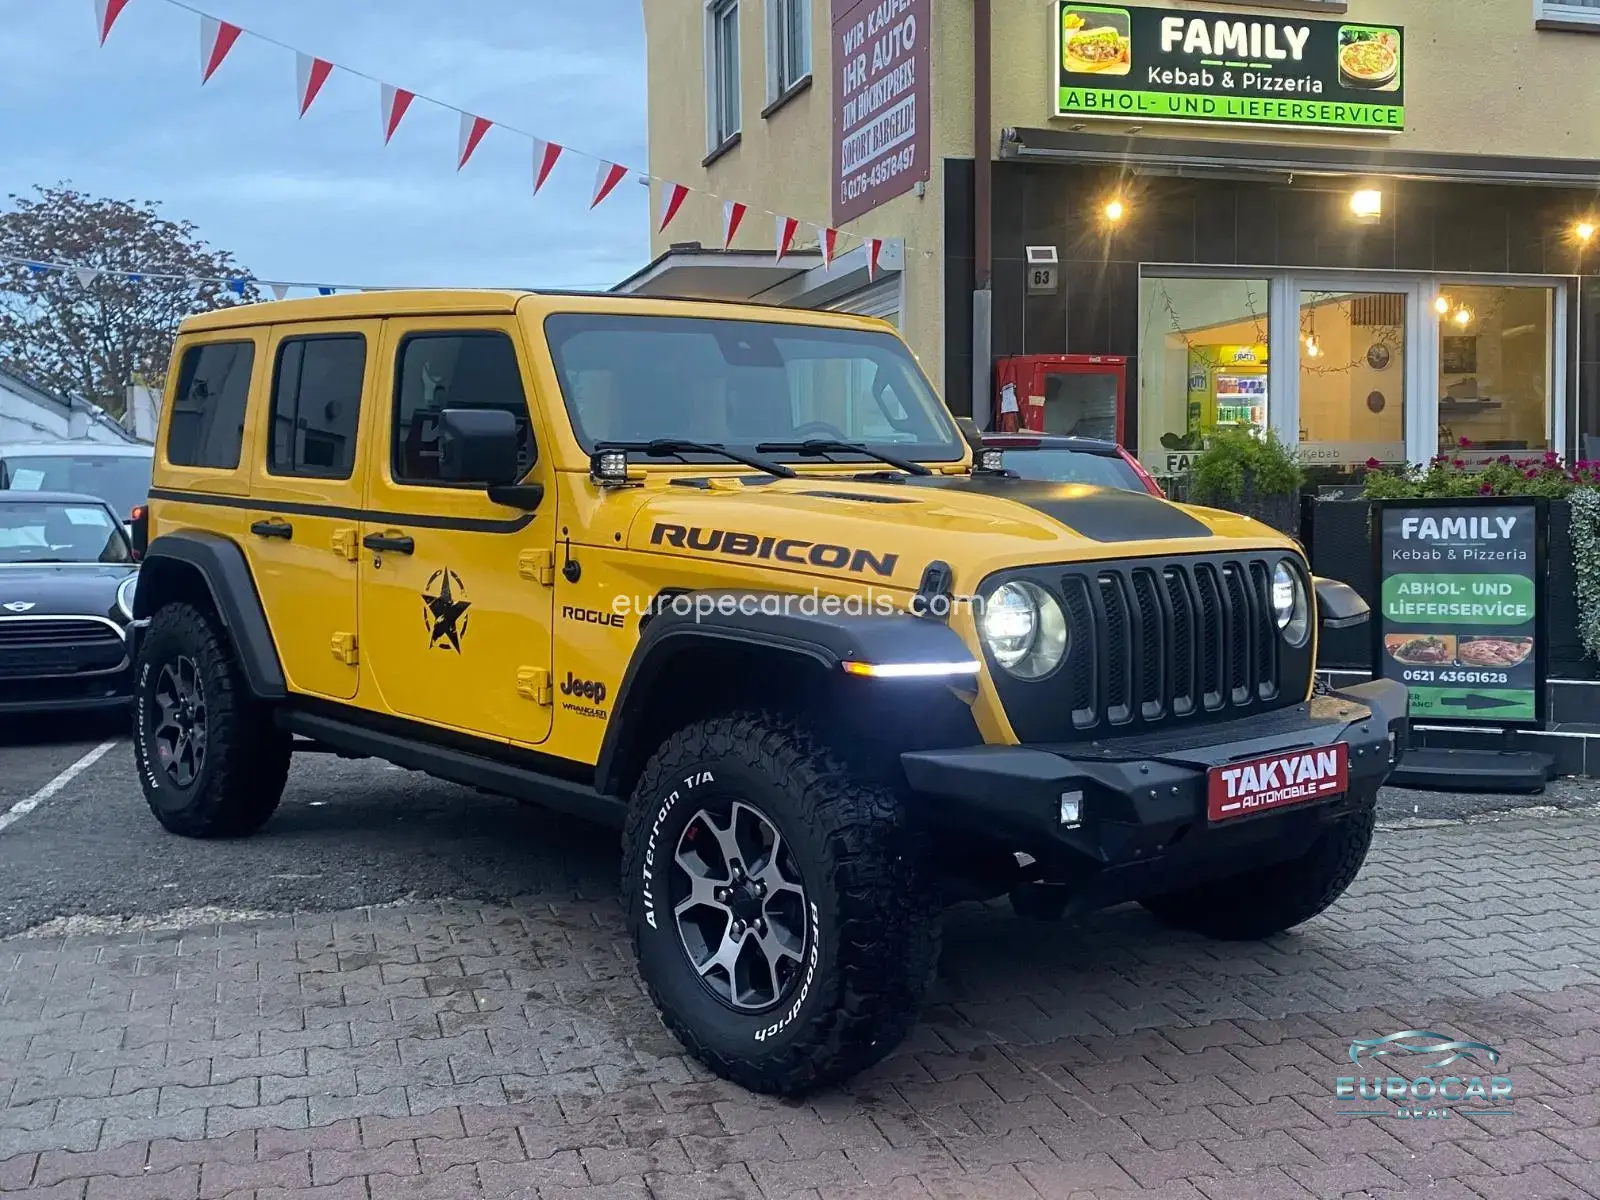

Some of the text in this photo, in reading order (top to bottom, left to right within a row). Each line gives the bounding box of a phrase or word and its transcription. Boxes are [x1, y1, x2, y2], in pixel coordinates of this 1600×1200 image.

[842, 0, 915, 57] WIR KAUFE
[1160, 16, 1311, 61] FAMILY
[843, 14, 917, 97] IHR AUTO
[842, 56, 916, 132] ZUM HÖCHSTPREIS!
[1148, 66, 1324, 94] Kebab & Pizzeria
[1065, 90, 1399, 125] ABHOL- UND LIEFERSERVICE
[843, 101, 915, 170] SOFORT BARGELD!
[847, 143, 916, 200] 0176-43678497
[1034, 271, 1050, 285] 63
[1303, 449, 1341, 460] Kebab
[1401, 516, 1517, 540] FAMILY
[649, 522, 900, 578] RUBICON
[1391, 548, 1528, 561] Kebab & Pizzeria
[1397, 582, 1513, 597] ABHOL- UND
[562, 605, 625, 629] ROGUE
[560, 671, 607, 705] Jeep
[1402, 670, 1509, 684] 0621 43661628
[561, 701, 608, 717] WRANGLER
[1221, 749, 1338, 798] TAKYAN
[1242, 782, 1318, 810] AUTOMOBILE
[642, 770, 715, 930] All-Terrain T/A
[754, 900, 820, 1042] BFGoodrich
